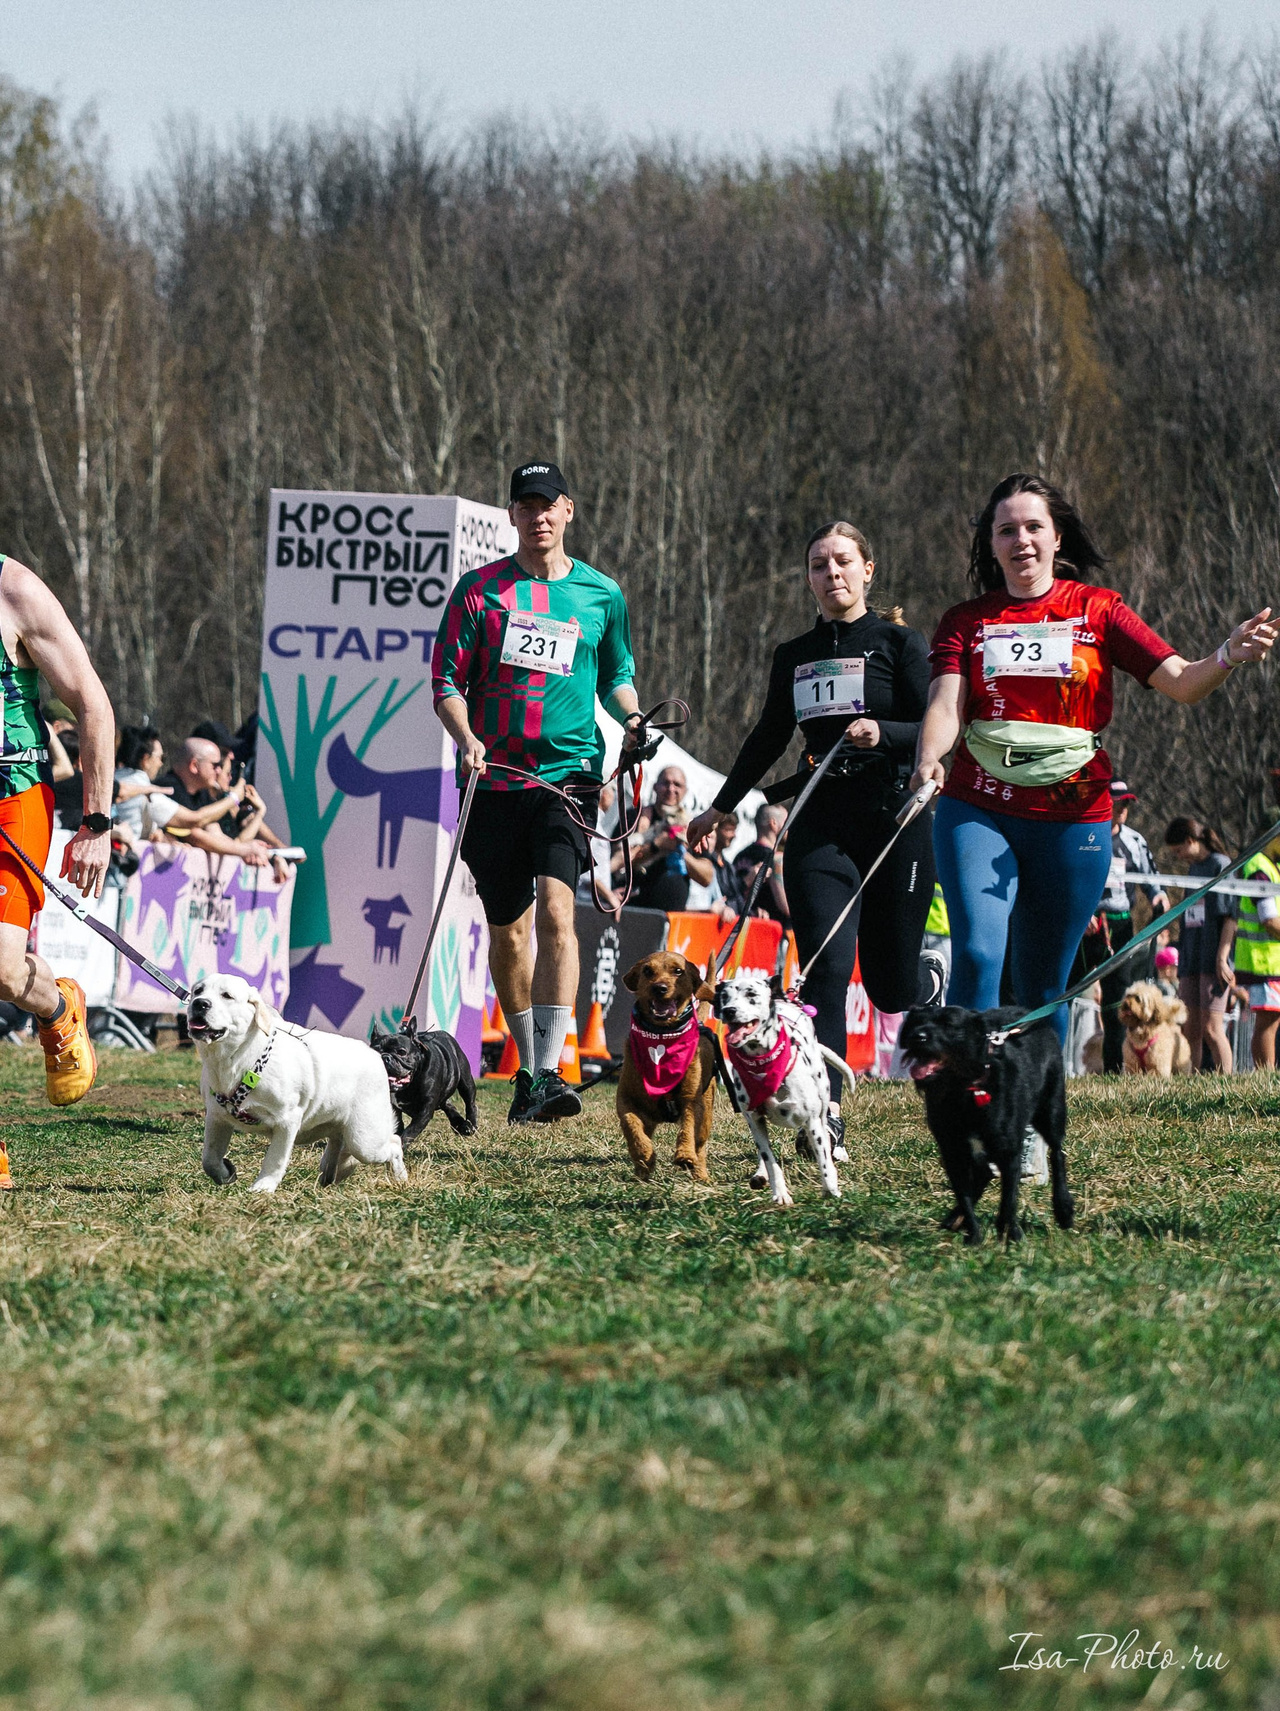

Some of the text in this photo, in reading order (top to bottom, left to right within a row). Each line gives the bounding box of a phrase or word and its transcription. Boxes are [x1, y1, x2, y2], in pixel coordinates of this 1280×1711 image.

[521, 465, 550, 476] SORRY
[278, 501, 414, 538] КРОСС
[275, 530, 450, 574] БЫСТРЫЙ
[268, 623, 437, 664] СТАРТ
[518, 634, 558, 660] 231
[1010, 642, 1043, 662] 93
[811, 679, 835, 703] 11
